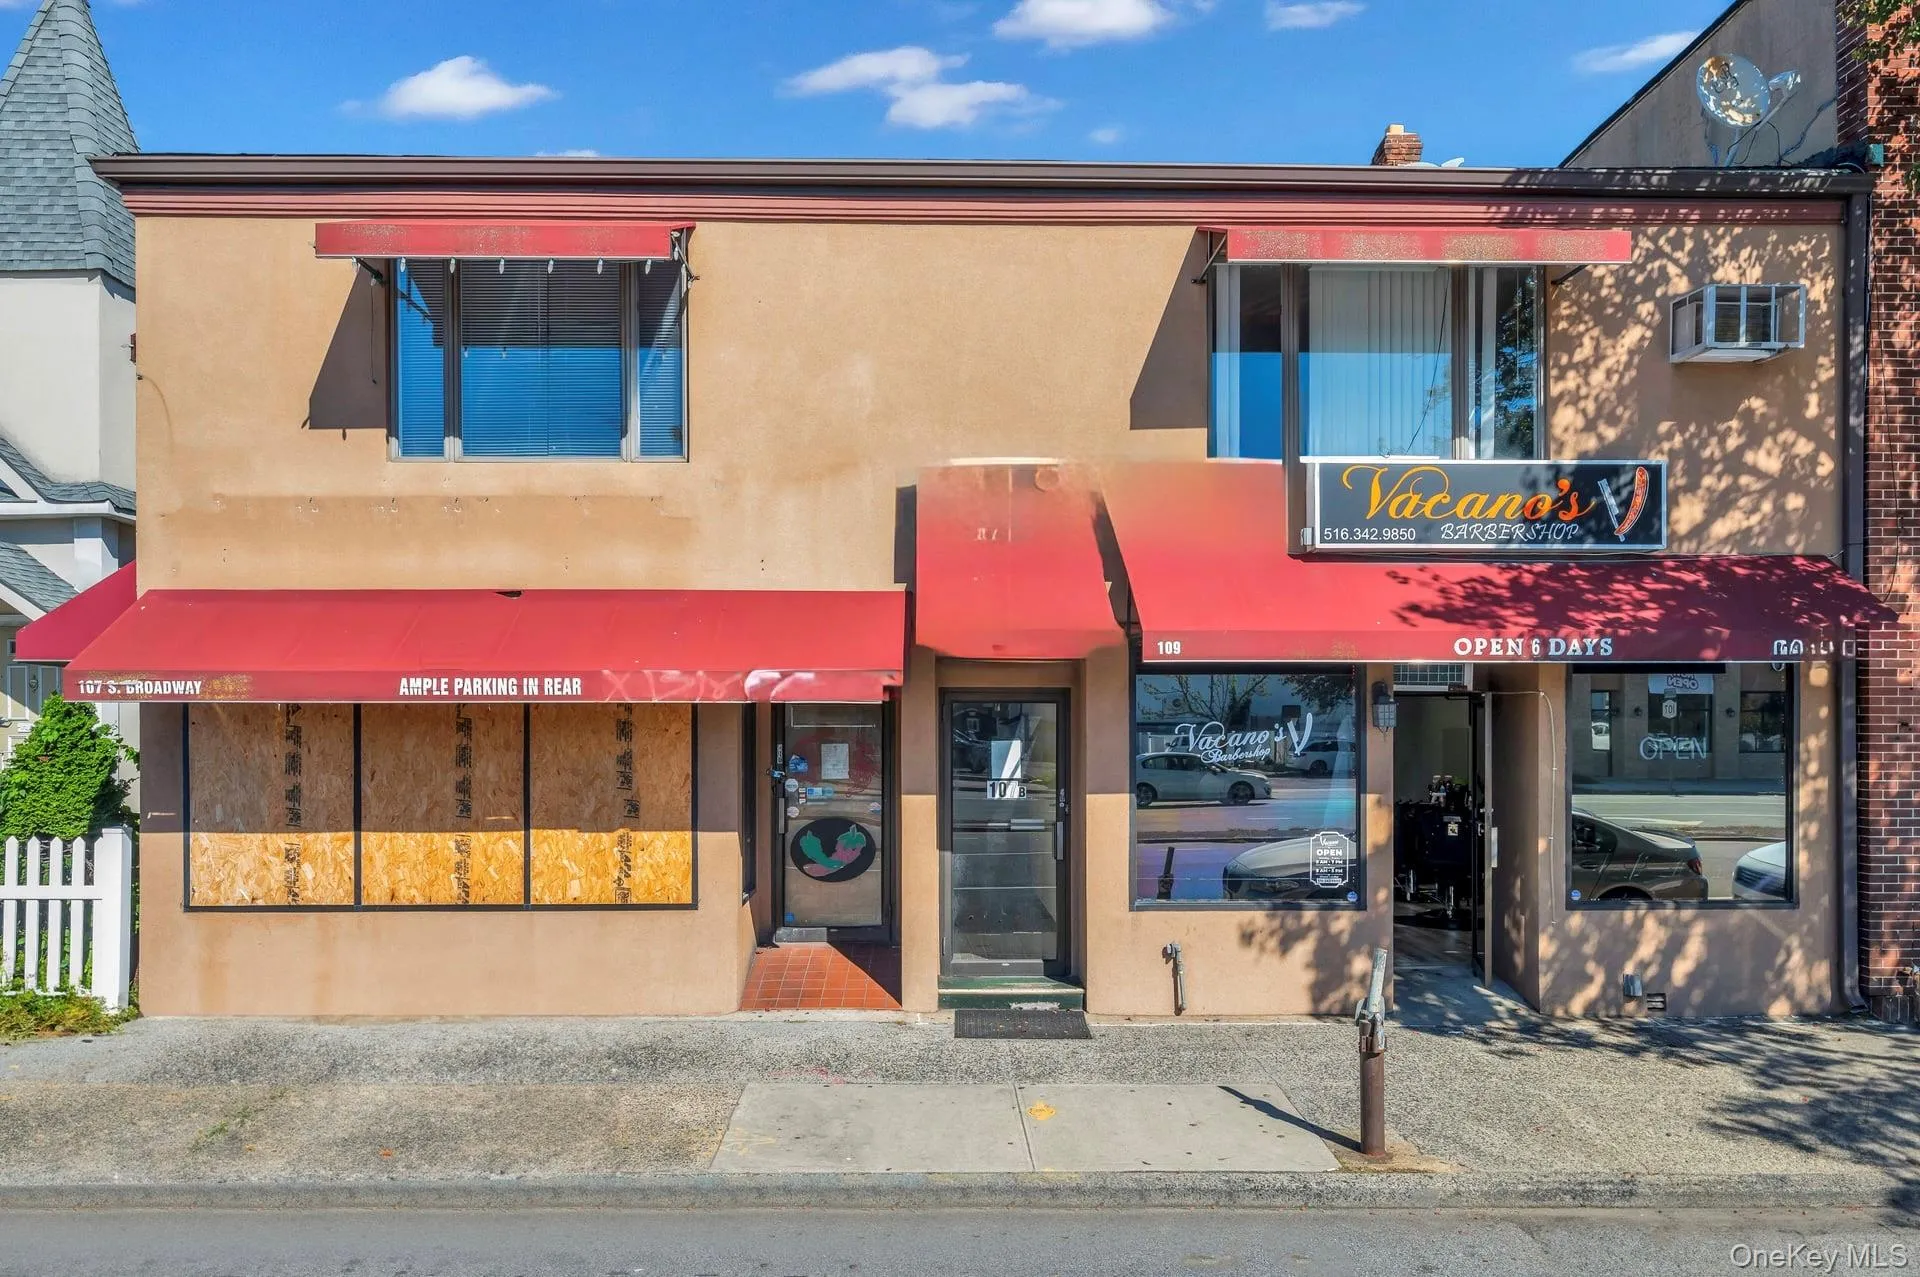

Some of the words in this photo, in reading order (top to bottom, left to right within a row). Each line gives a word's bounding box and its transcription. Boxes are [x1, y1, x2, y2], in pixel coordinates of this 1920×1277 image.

[1342, 464, 1597, 521] Vacano's
[1323, 527, 1416, 541] 516.342.9850
[1441, 523, 1581, 541] BARBERSHOP
[1157, 641, 1181, 655] 109
[1454, 638, 1525, 655] OPEN
[1531, 638, 1541, 656] 6
[1549, 638, 1613, 655] DAYS
[78, 681, 102, 694] 107
[108, 681, 121, 694] S.
[126, 681, 202, 694] BROADWAY
[399, 678, 449, 696] AMPLE
[454, 678, 518, 696] PARKING
[524, 678, 537, 696] IN
[543, 678, 581, 696] REAR
[1174, 721, 1287, 752] Vacano's
[1200, 744, 1271, 763] Barbershop
[1640, 738, 1706, 760] OPEN
[1316, 848, 1343, 856] OPEN
